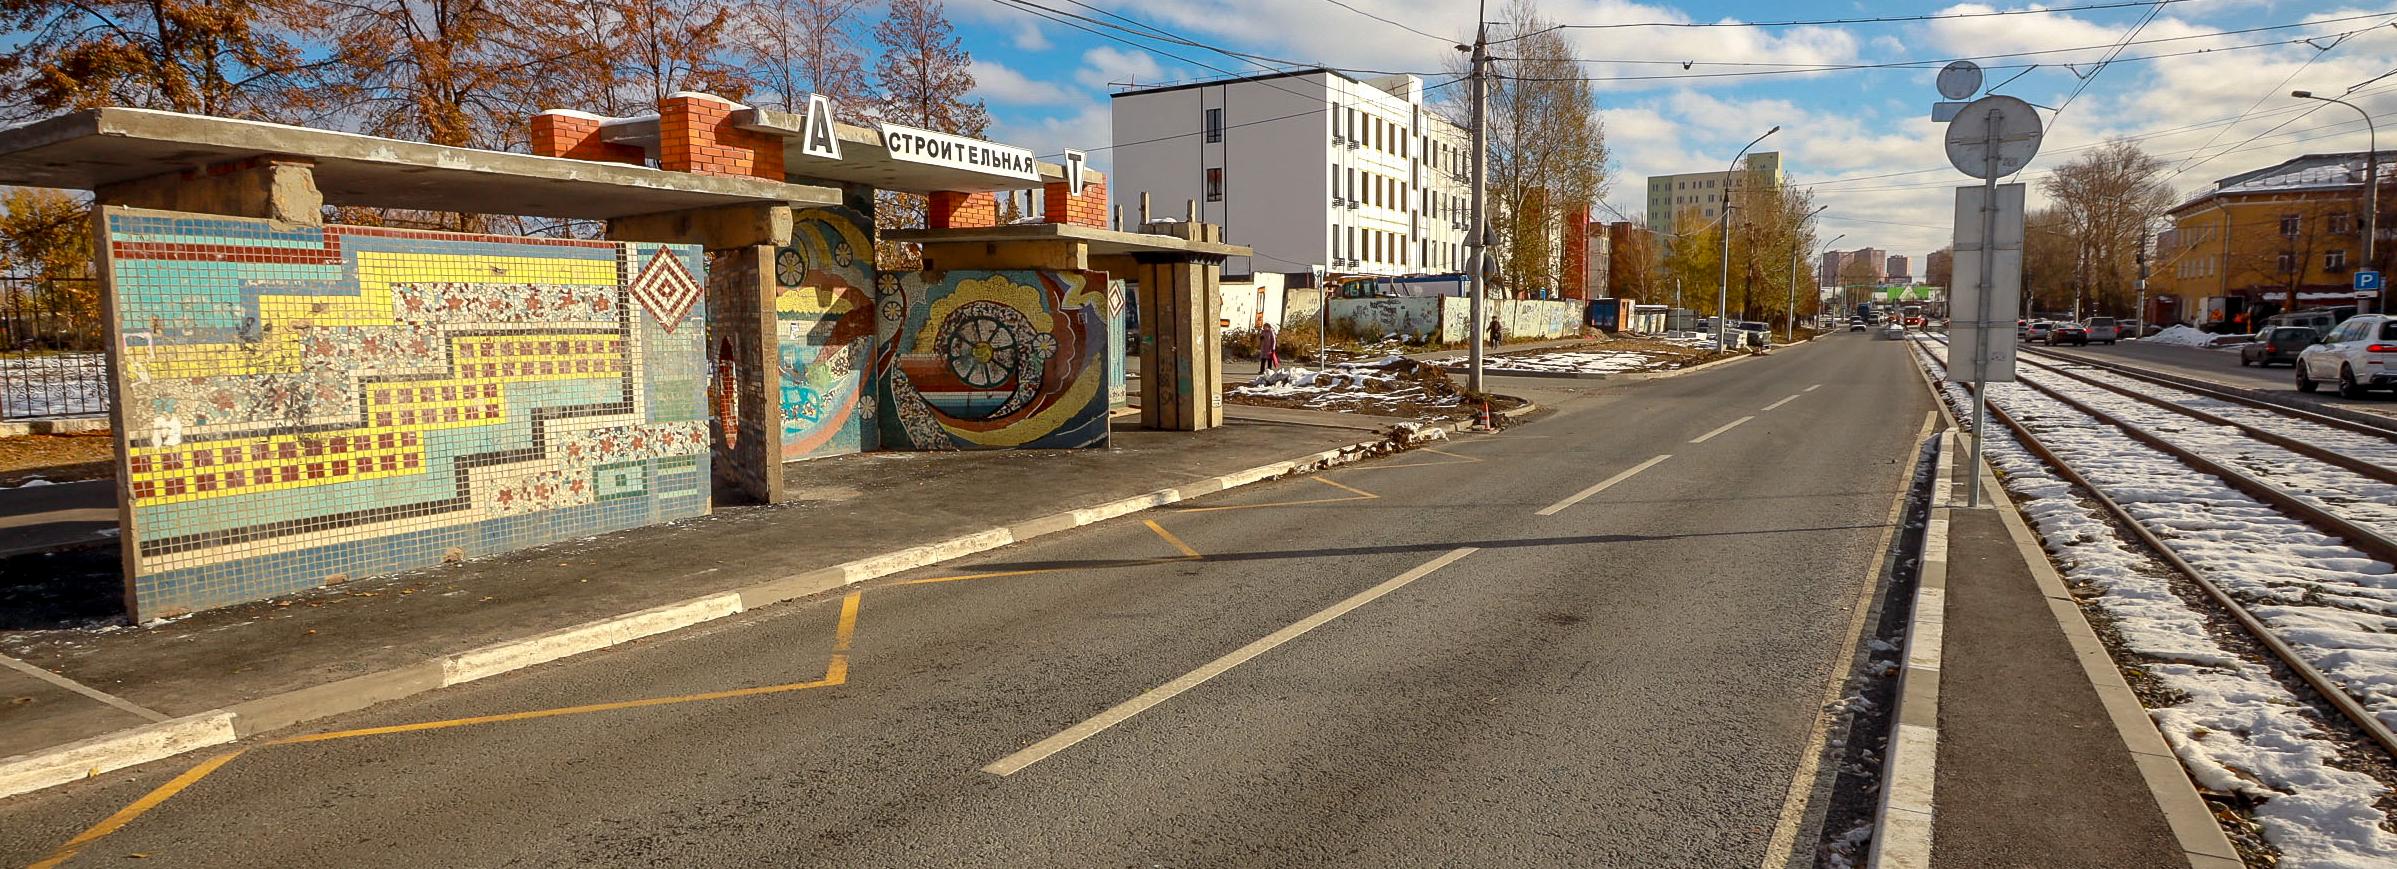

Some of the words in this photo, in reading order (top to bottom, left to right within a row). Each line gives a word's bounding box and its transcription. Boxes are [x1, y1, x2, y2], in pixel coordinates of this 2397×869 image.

[809, 99, 833, 154] А
[888, 132, 1034, 174] СТРОИТЕЛЬНАЯ
[1067, 153, 1082, 194] Т
[2360, 274, 2374, 287] P
